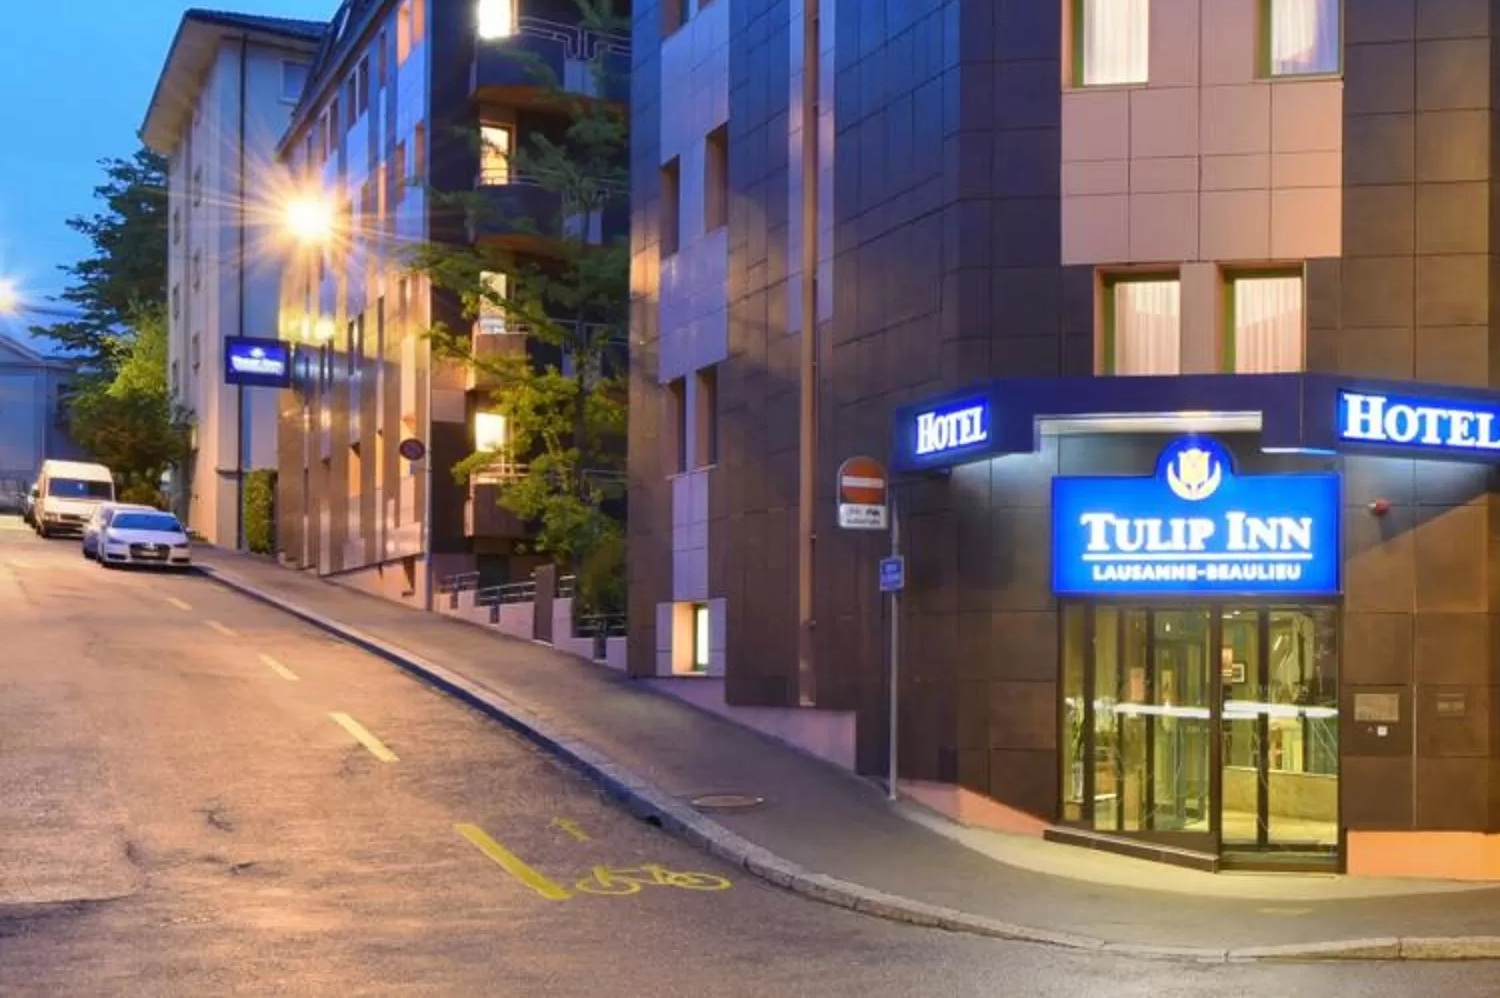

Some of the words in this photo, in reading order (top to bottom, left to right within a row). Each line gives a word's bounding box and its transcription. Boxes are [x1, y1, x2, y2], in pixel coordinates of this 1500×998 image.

[916, 406, 988, 455] HOTEL
[1080, 512, 1216, 552] TULIP
[1225, 511, 1313, 551] INN
[1092, 563, 1301, 582] LAUSANNE-BEAULIEU
